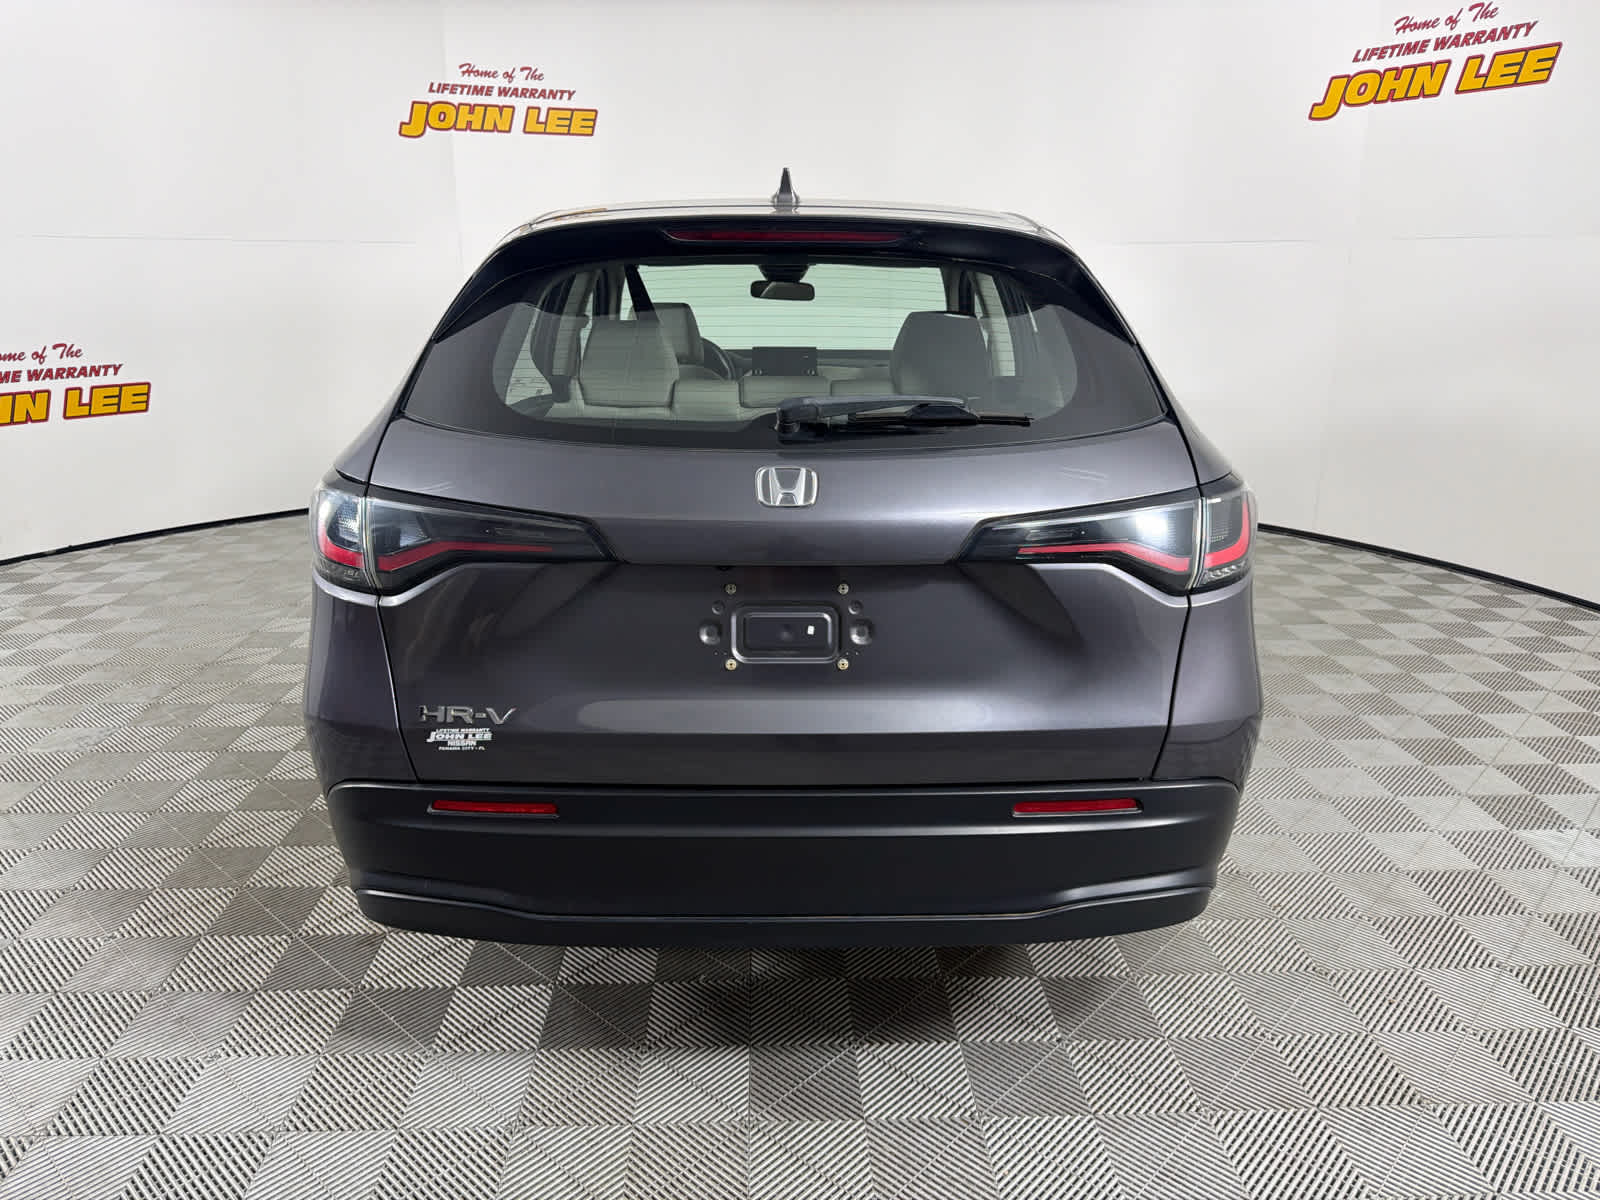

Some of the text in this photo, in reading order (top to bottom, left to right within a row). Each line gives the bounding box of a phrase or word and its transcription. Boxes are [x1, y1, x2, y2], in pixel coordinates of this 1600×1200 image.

[1394, 1, 1498, 35] Home of The
[1352, 21, 1538, 63] LIFETIME WARRANTY
[458, 63, 545, 83] Home of The
[1308, 42, 1563, 121] JOHN LEE
[428, 82, 576, 100] LIFETIME WARRANTY
[399, 101, 598, 138] JOHN LEE
[31, 346, 47, 364] of
[52, 343, 83, 359] The
[27, 363, 123, 382] WARRANTY
[63, 382, 151, 419] LEE
[420, 705, 516, 725] HR-V
[426, 731, 492, 742] JOHN LEE
